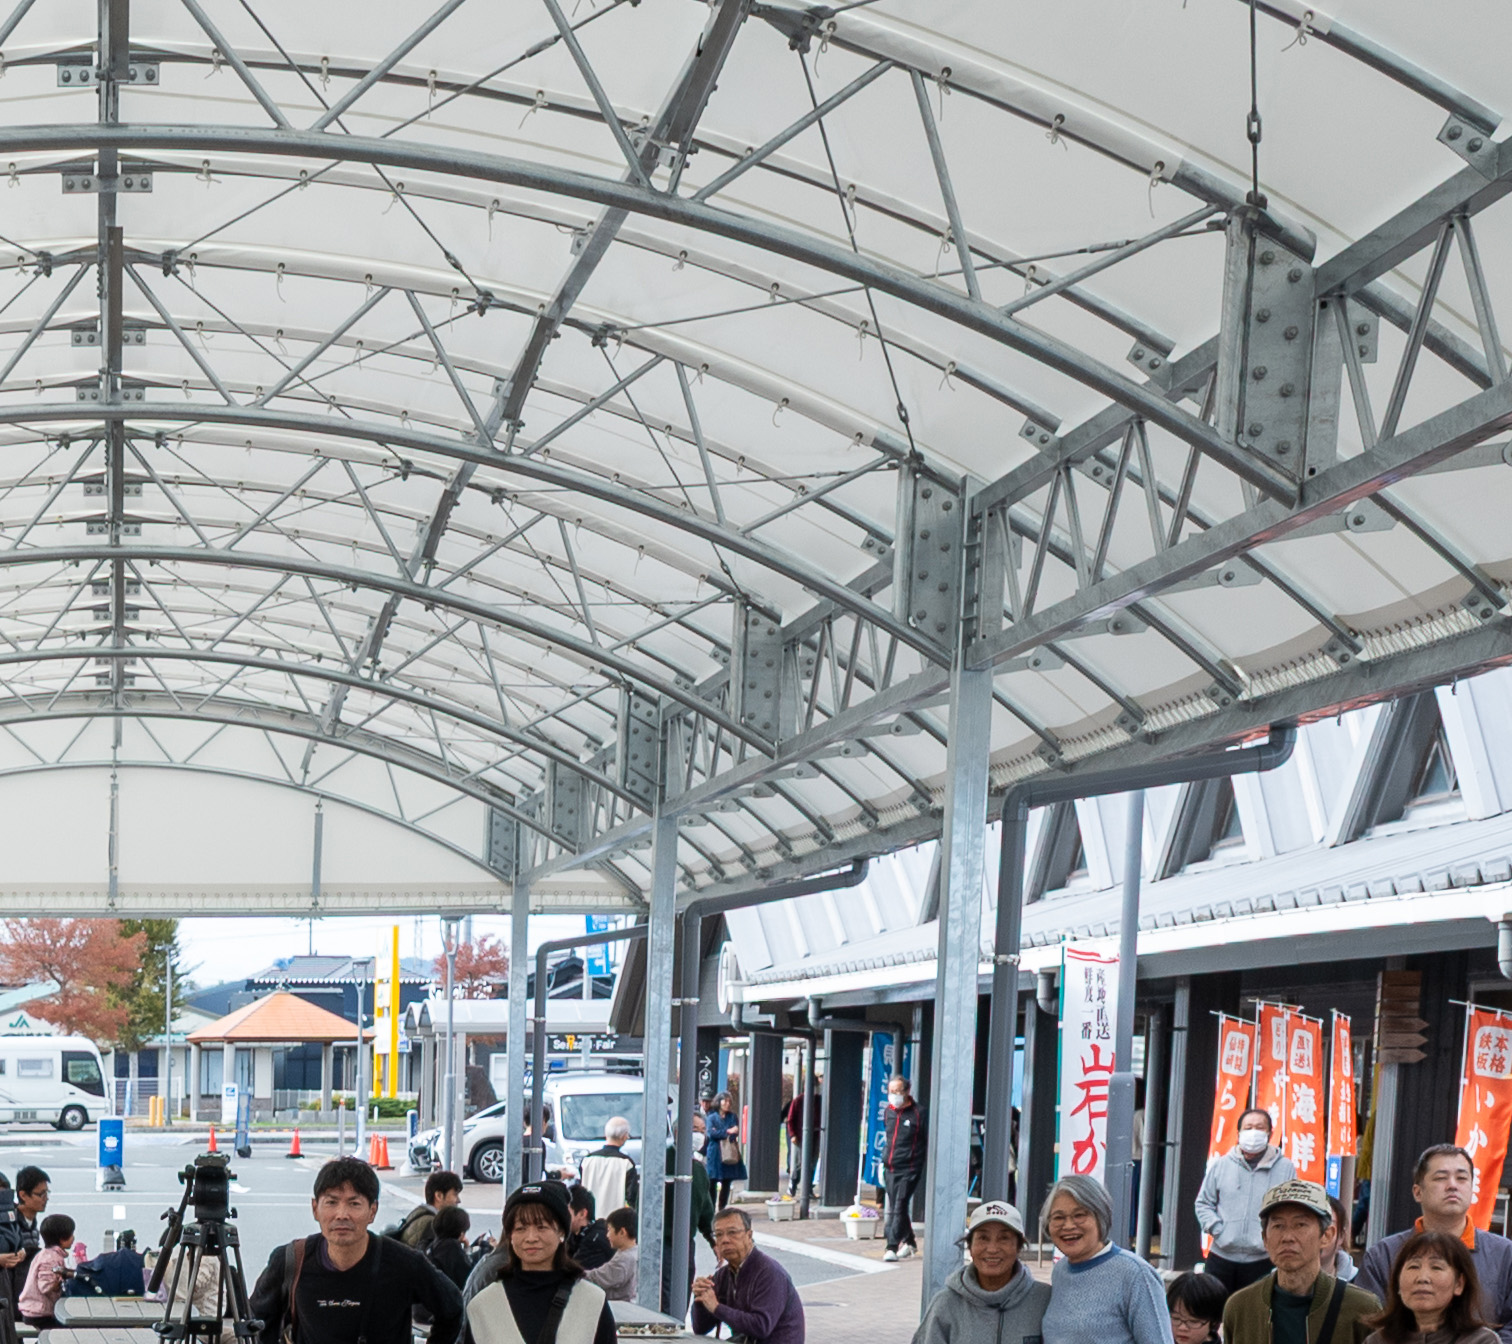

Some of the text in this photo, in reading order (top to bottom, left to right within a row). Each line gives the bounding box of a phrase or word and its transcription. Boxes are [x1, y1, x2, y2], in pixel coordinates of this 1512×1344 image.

[595, 1038, 616, 1051] Fair
[1476, 1032, 1491, 1070] 鉄板
[1489, 1033, 1510, 1074] 本格
